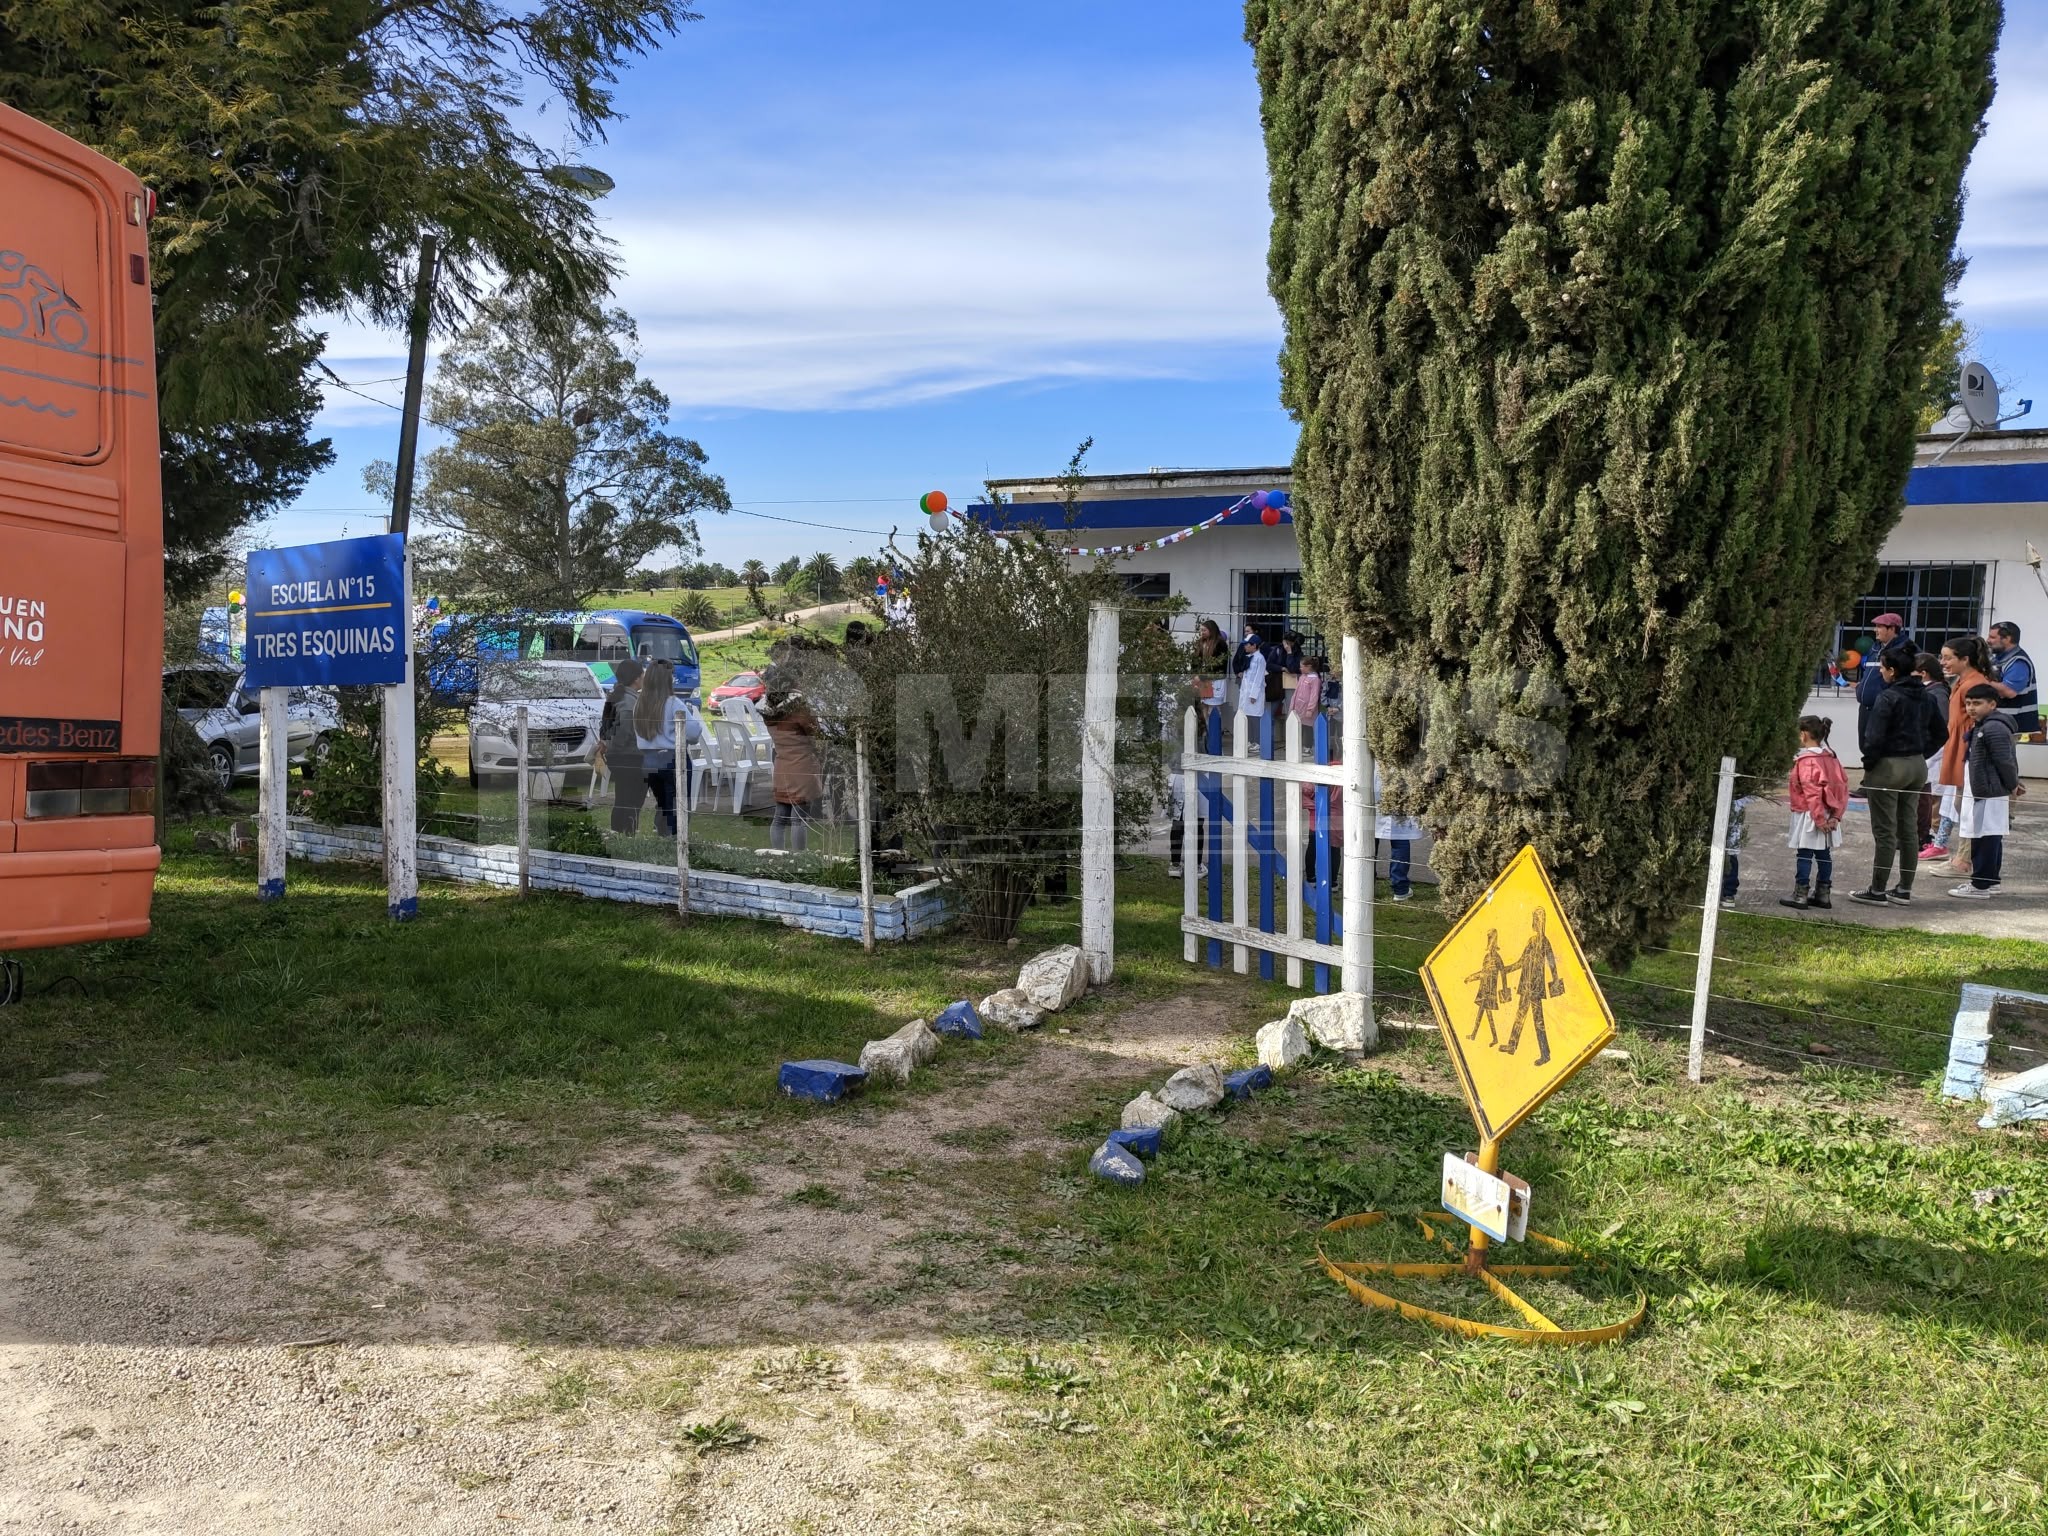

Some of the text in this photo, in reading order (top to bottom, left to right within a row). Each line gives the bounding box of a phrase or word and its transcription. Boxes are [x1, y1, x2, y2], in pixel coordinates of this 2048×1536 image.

[271, 578, 335, 606] ESCUELA
[4, 616, 44, 642] NO
[254, 625, 395, 659] TRES ESQUINAS
[10, 645, 45, 666] Vial
